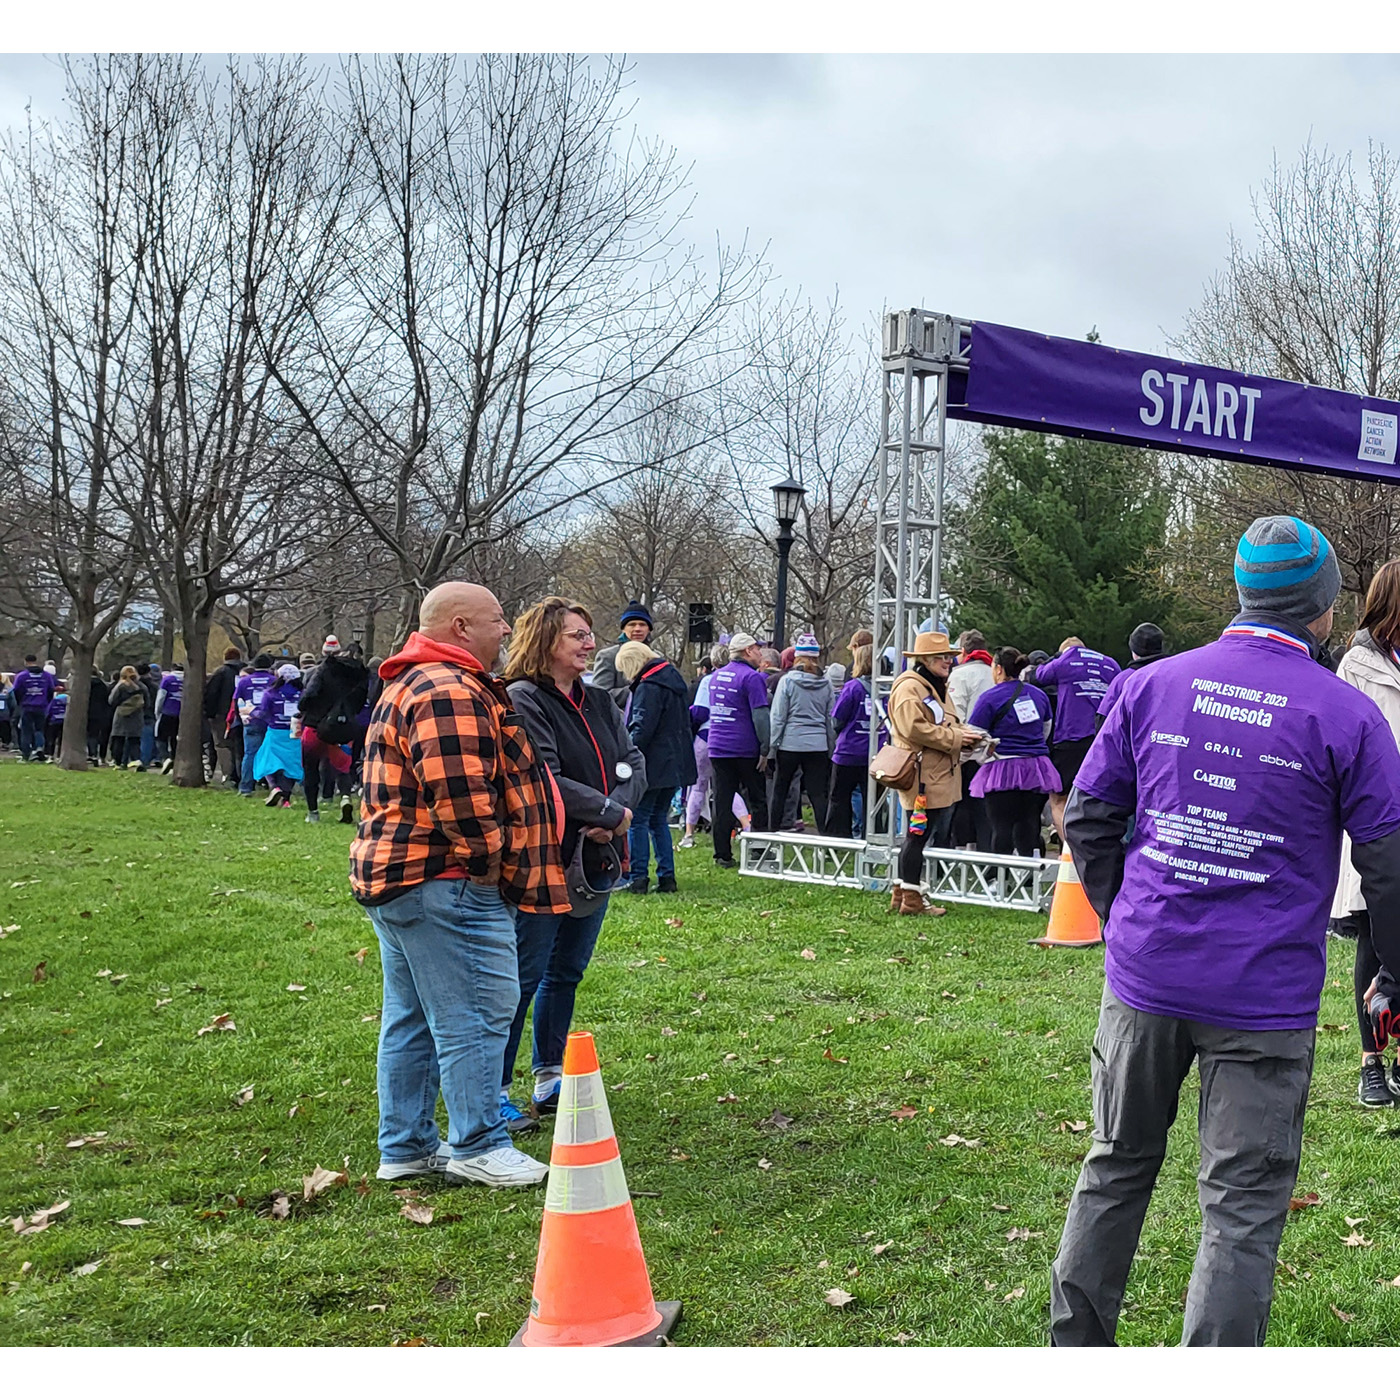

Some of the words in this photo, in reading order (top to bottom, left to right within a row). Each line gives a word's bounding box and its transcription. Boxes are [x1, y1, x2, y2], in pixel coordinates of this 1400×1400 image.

[1140, 369, 1262, 442] START
[1366, 426, 1385, 437] CANCER
[1365, 436, 1382, 446] ACTION
[1363, 447, 1386, 457] NETWORK
[1191, 678, 1263, 703] PURPLESTRIDE
[1263, 692, 1288, 708] 2023
[1192, 694, 1273, 728] Minnesota
[1156, 732, 1190, 745] IPSEN
[1204, 742, 1243, 758] GRAIL
[1258, 754, 1303, 771] abbvie
[1187, 804, 1202, 816] TOP
[1203, 807, 1228, 822] TEAMS
[1221, 840, 1235, 849] TEAM
[1266, 833, 1285, 843] COFFEE
[1188, 840, 1202, 850] TEAM
[1201, 844, 1216, 852] MAKE
[1168, 856, 1198, 871] CANCER
[1197, 862, 1227, 877] ACTION
